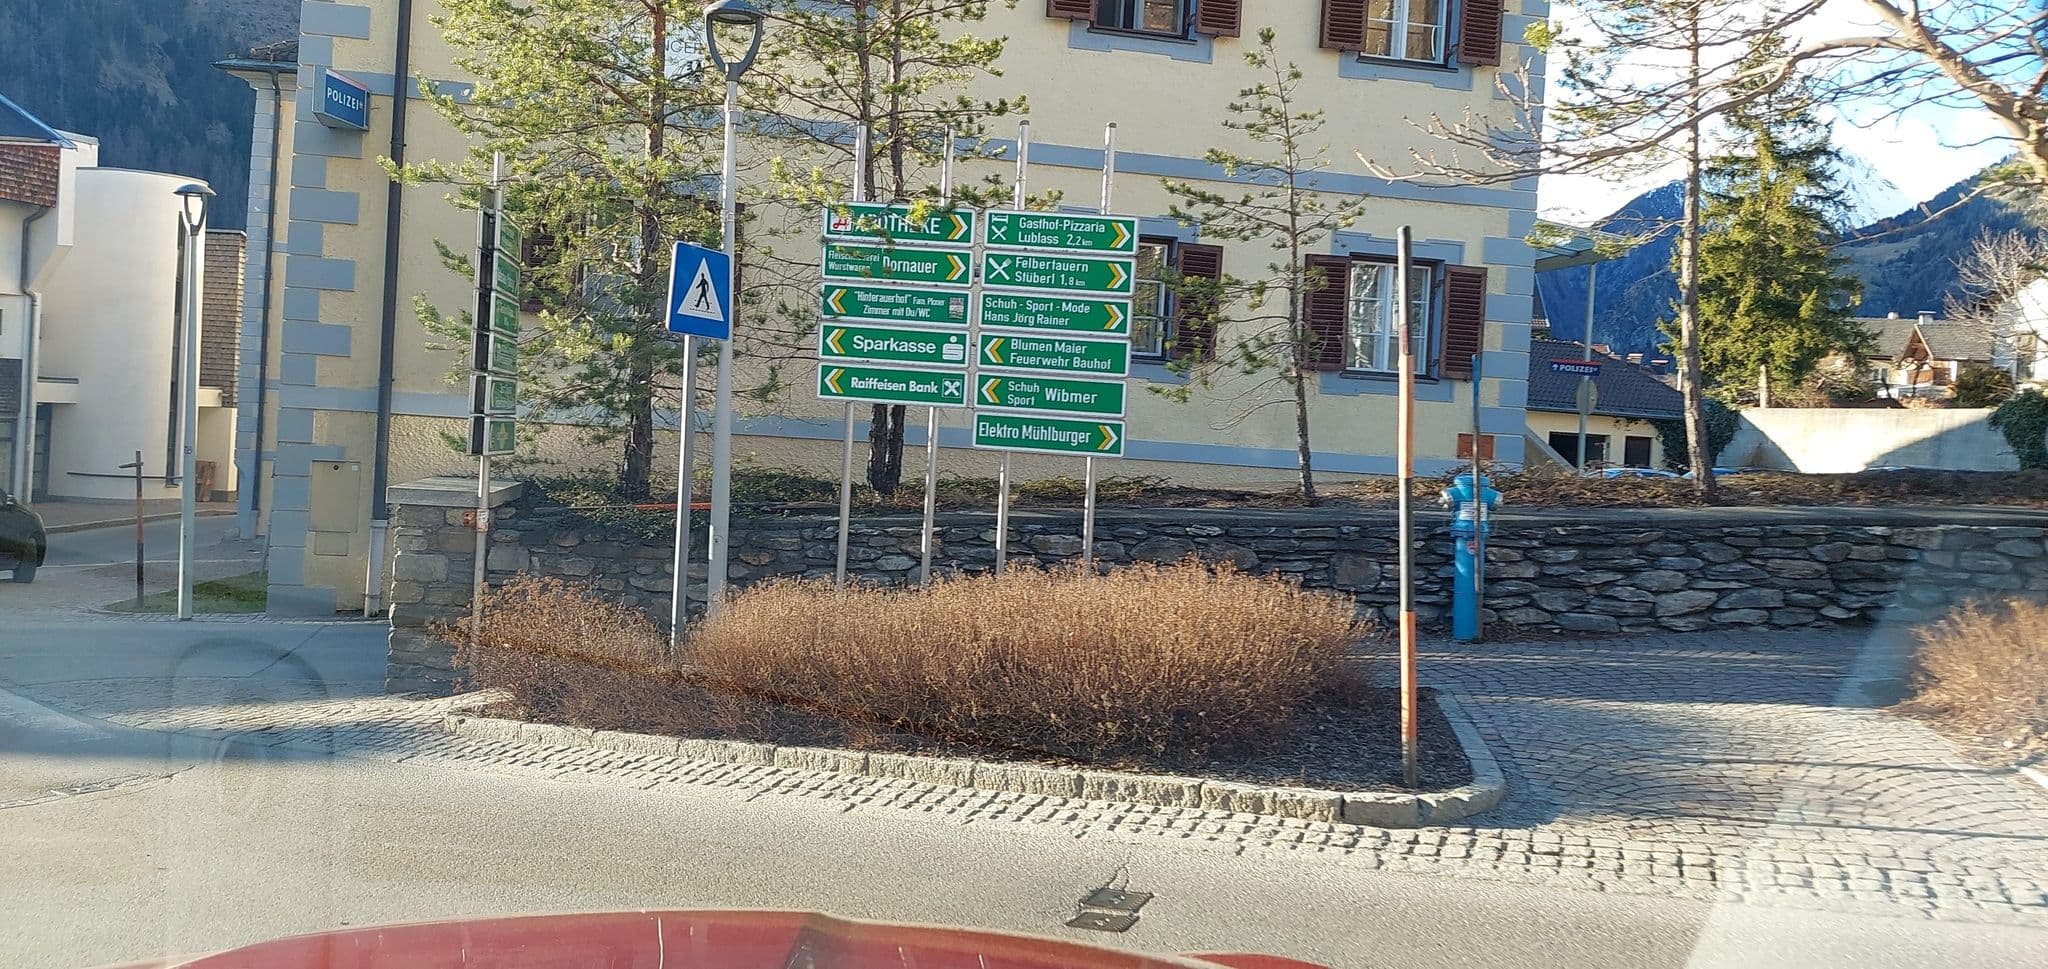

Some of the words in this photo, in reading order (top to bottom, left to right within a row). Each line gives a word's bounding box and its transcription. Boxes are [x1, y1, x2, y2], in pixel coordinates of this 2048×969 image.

[327, 87, 359, 111] POLIZEI
[1019, 217, 1106, 233] Gasthof-Pizzaria
[1018, 231, 1059, 245] Lublass
[882, 256, 938, 274] Dornauer
[1015, 257, 1089, 272] Felbertauern
[1015, 271, 1055, 284] Stüberl
[863, 305, 890, 316] Zimmer
[892, 306, 903, 317] mit
[985, 297, 1017, 310] Schuh
[1026, 300, 1053, 313] Sport
[1061, 302, 1090, 314] Mode
[984, 310, 1010, 322] Hans
[1013, 312, 1035, 326] Jörg
[1036, 314, 1070, 326] Rainer
[852, 335, 937, 354] Sparkasse
[1010, 338, 1053, 352] Blumen
[1054, 341, 1087, 354] Maier
[1010, 352, 1070, 368] Feuerwehr
[1072, 357, 1112, 370] Bauhof
[850, 377, 906, 392] Raiffeisen
[908, 380, 939, 394] Bank
[1007, 381, 1040, 393] Schuh
[1007, 394, 1035, 407] Sport
[1045, 387, 1098, 404] Wibmer
[979, 422, 1019, 439] Elektro
[1021, 424, 1092, 447] Mühlburger
